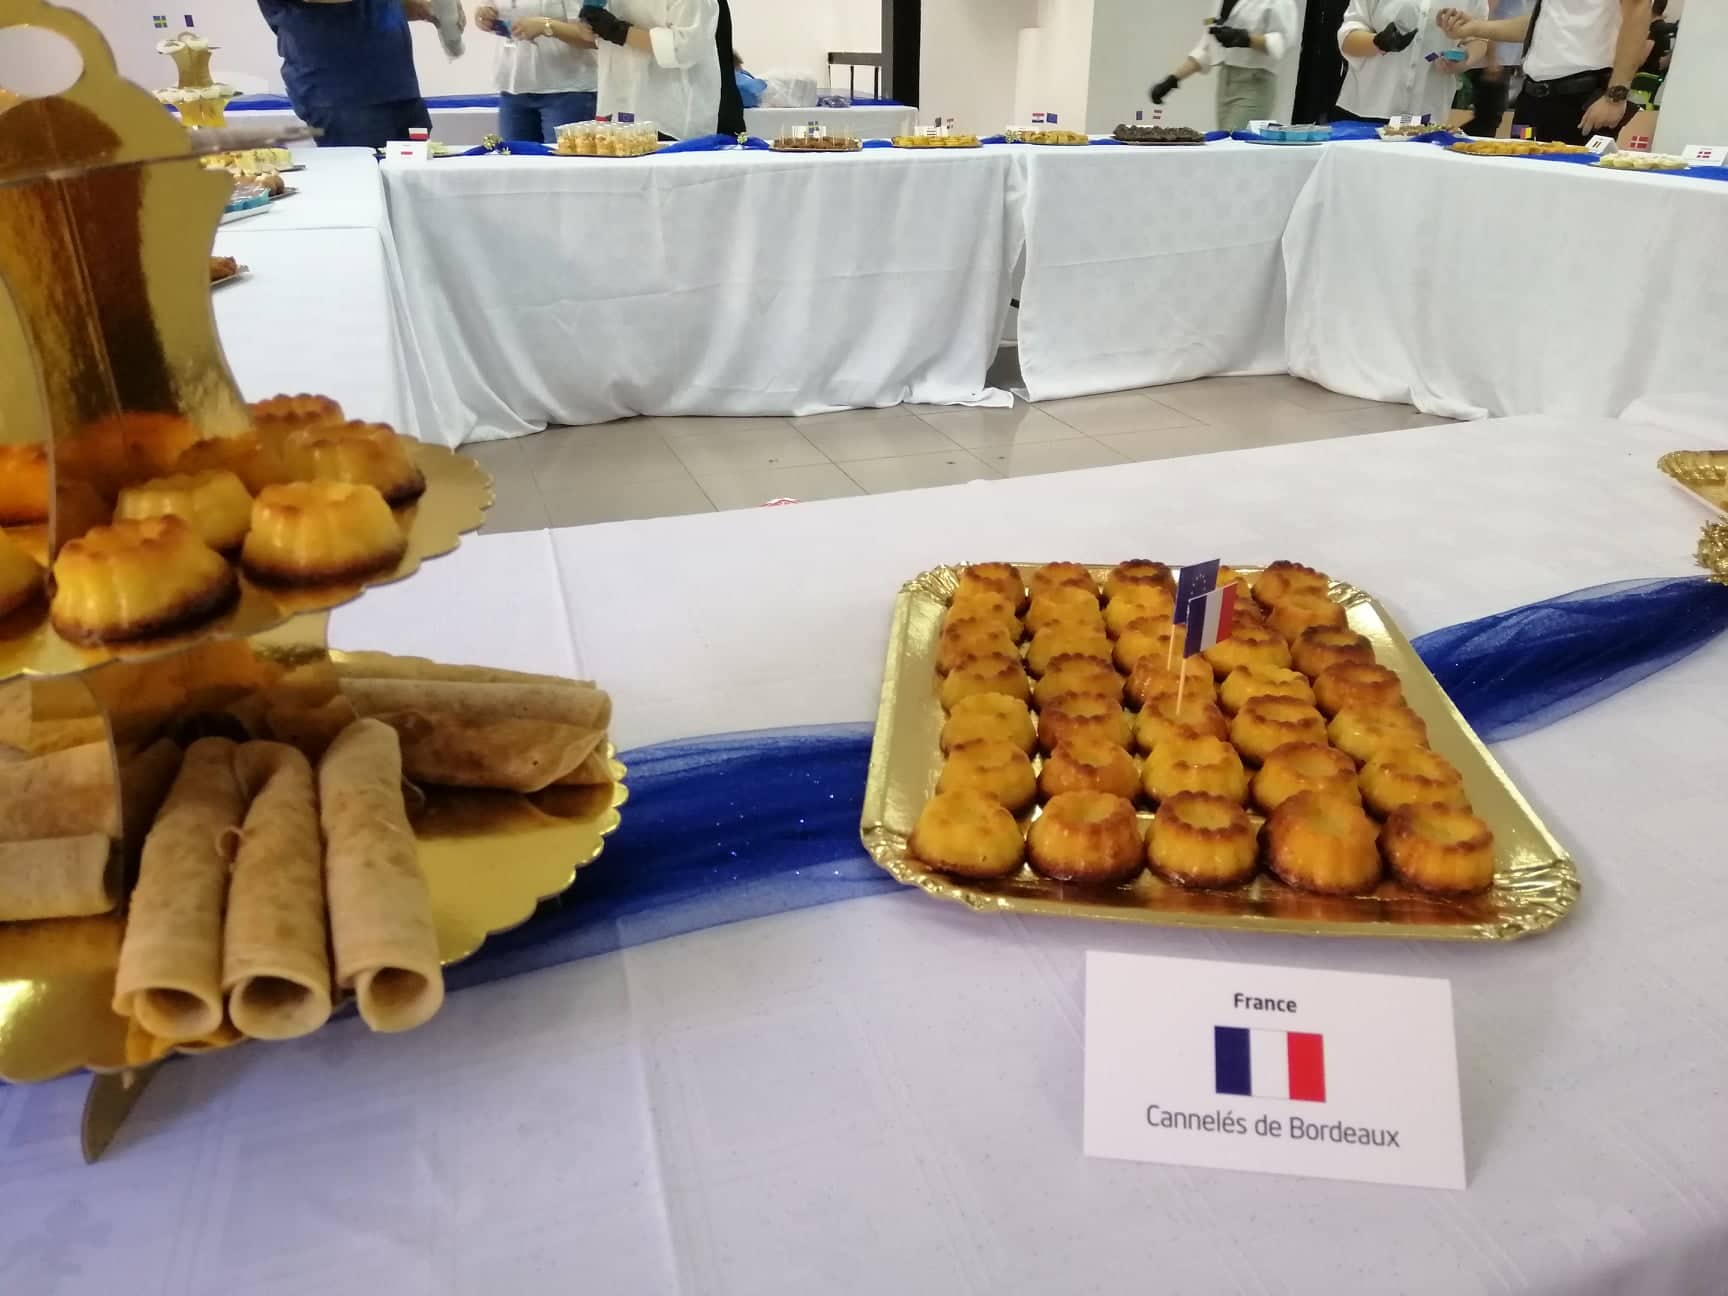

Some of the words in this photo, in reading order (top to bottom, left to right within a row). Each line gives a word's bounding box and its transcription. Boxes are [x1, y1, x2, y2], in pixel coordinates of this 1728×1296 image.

[1233, 992, 1298, 1014] France
[1146, 1104, 1248, 1135] Cannelés
[1254, 1114, 1282, 1138] de
[1289, 1116, 1401, 1148] Bordeaux
